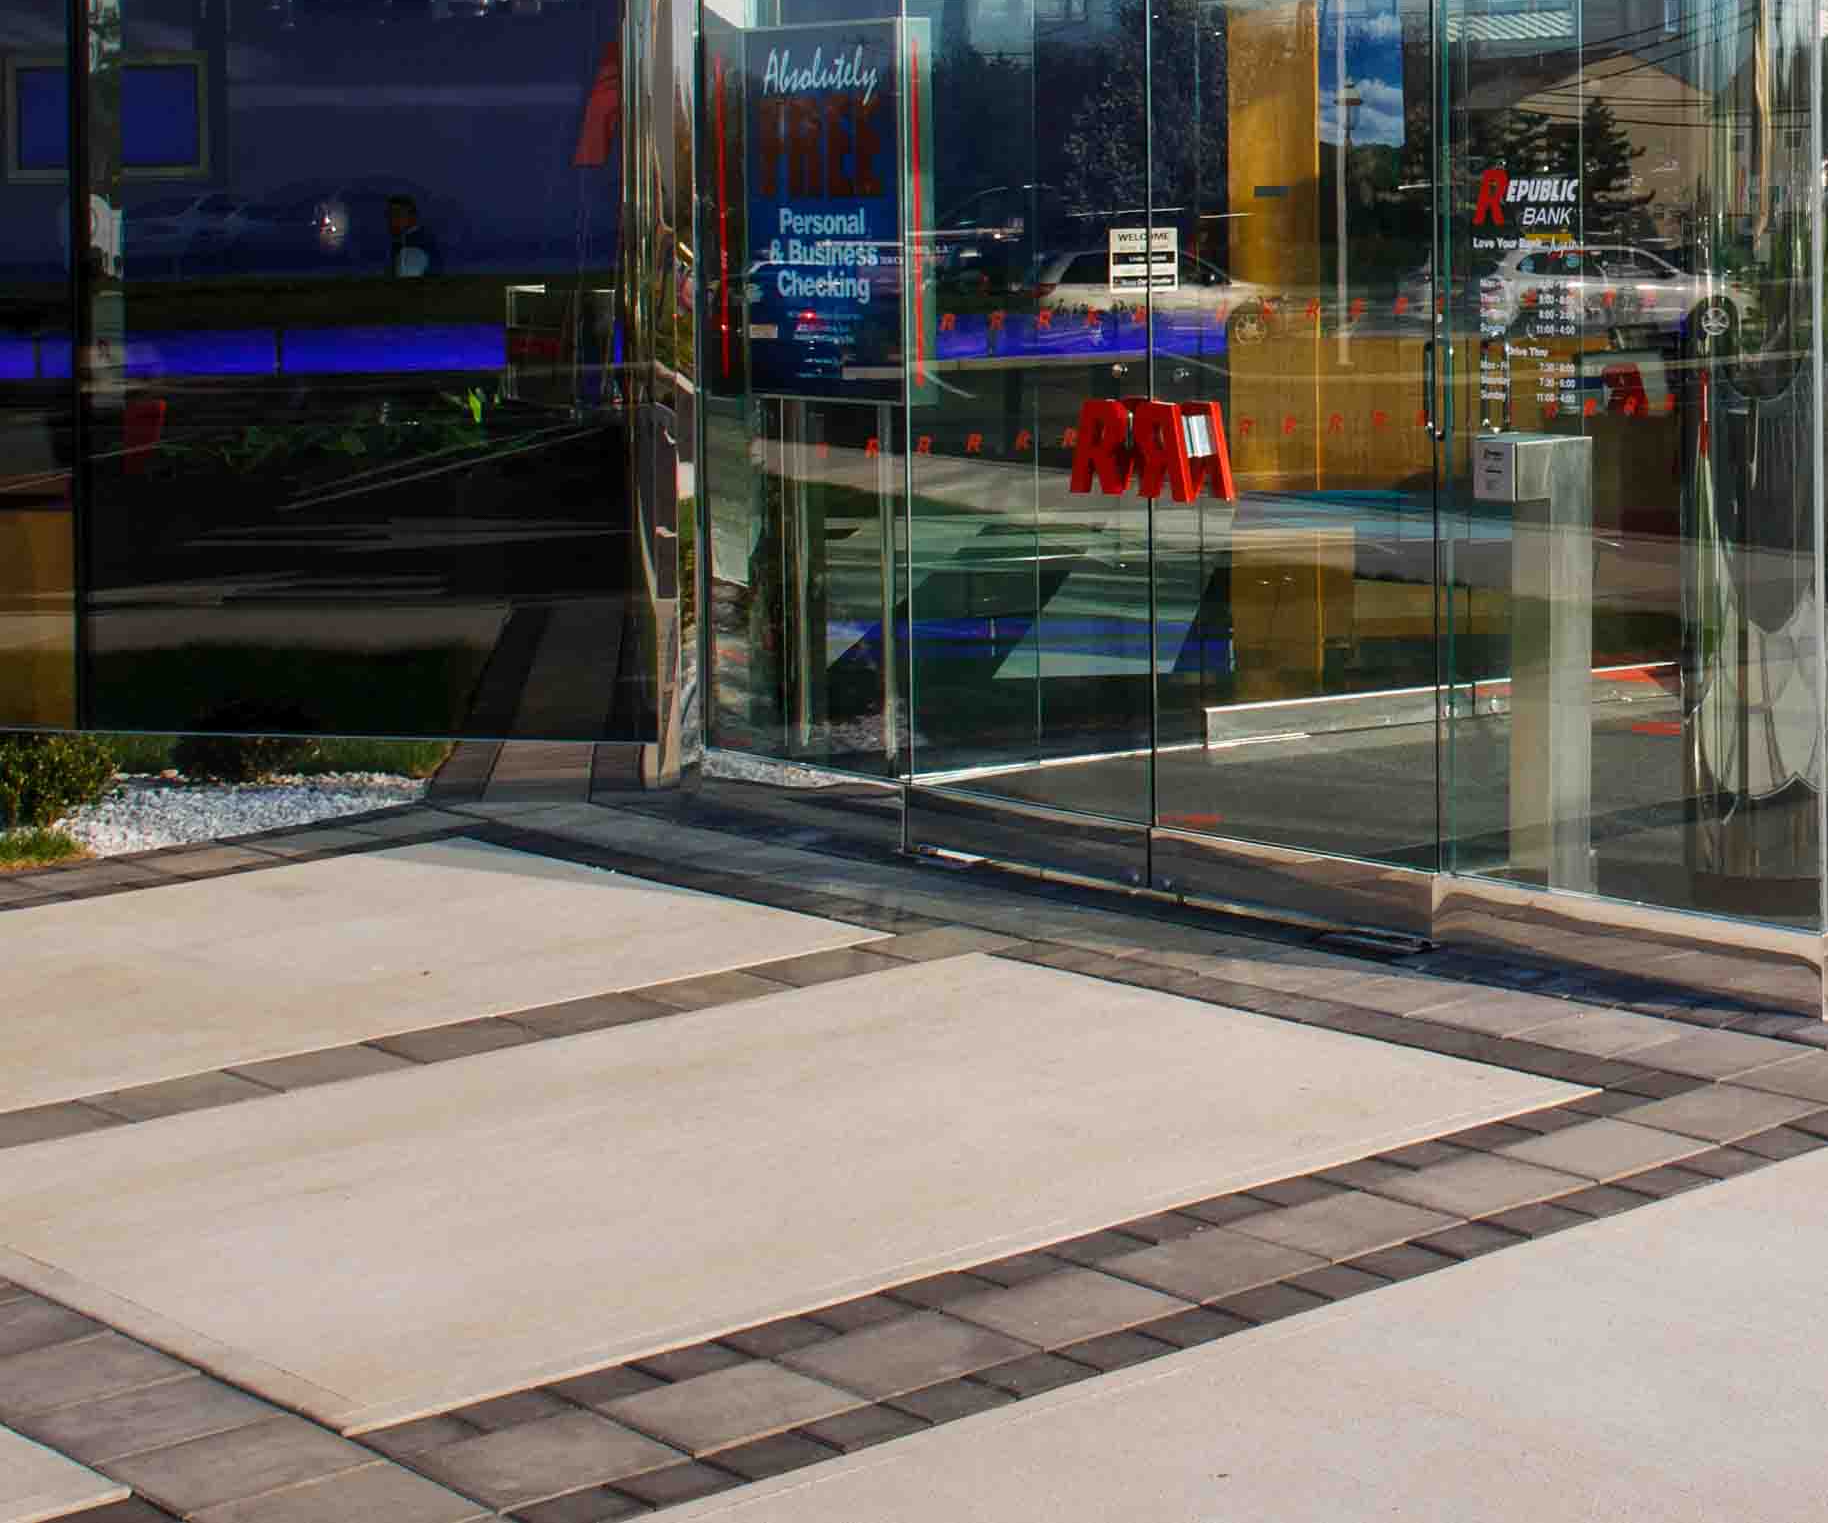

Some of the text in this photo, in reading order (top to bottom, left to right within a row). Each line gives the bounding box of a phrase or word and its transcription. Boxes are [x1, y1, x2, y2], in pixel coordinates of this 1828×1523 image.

[764, 45, 878, 106] Absolutely
[761, 96, 882, 196] FREE
[1472, 168, 1579, 225] REPUBLIC
[778, 208, 865, 235] Personal
[1522, 206, 1572, 225] BANK
[1118, 233, 1168, 241] WELCME
[1473, 238, 1495, 249] Love
[1496, 238, 1517, 249] Your
[769, 240, 785, 265] &
[789, 238, 880, 266] Business
[777, 270, 871, 305] Checking
